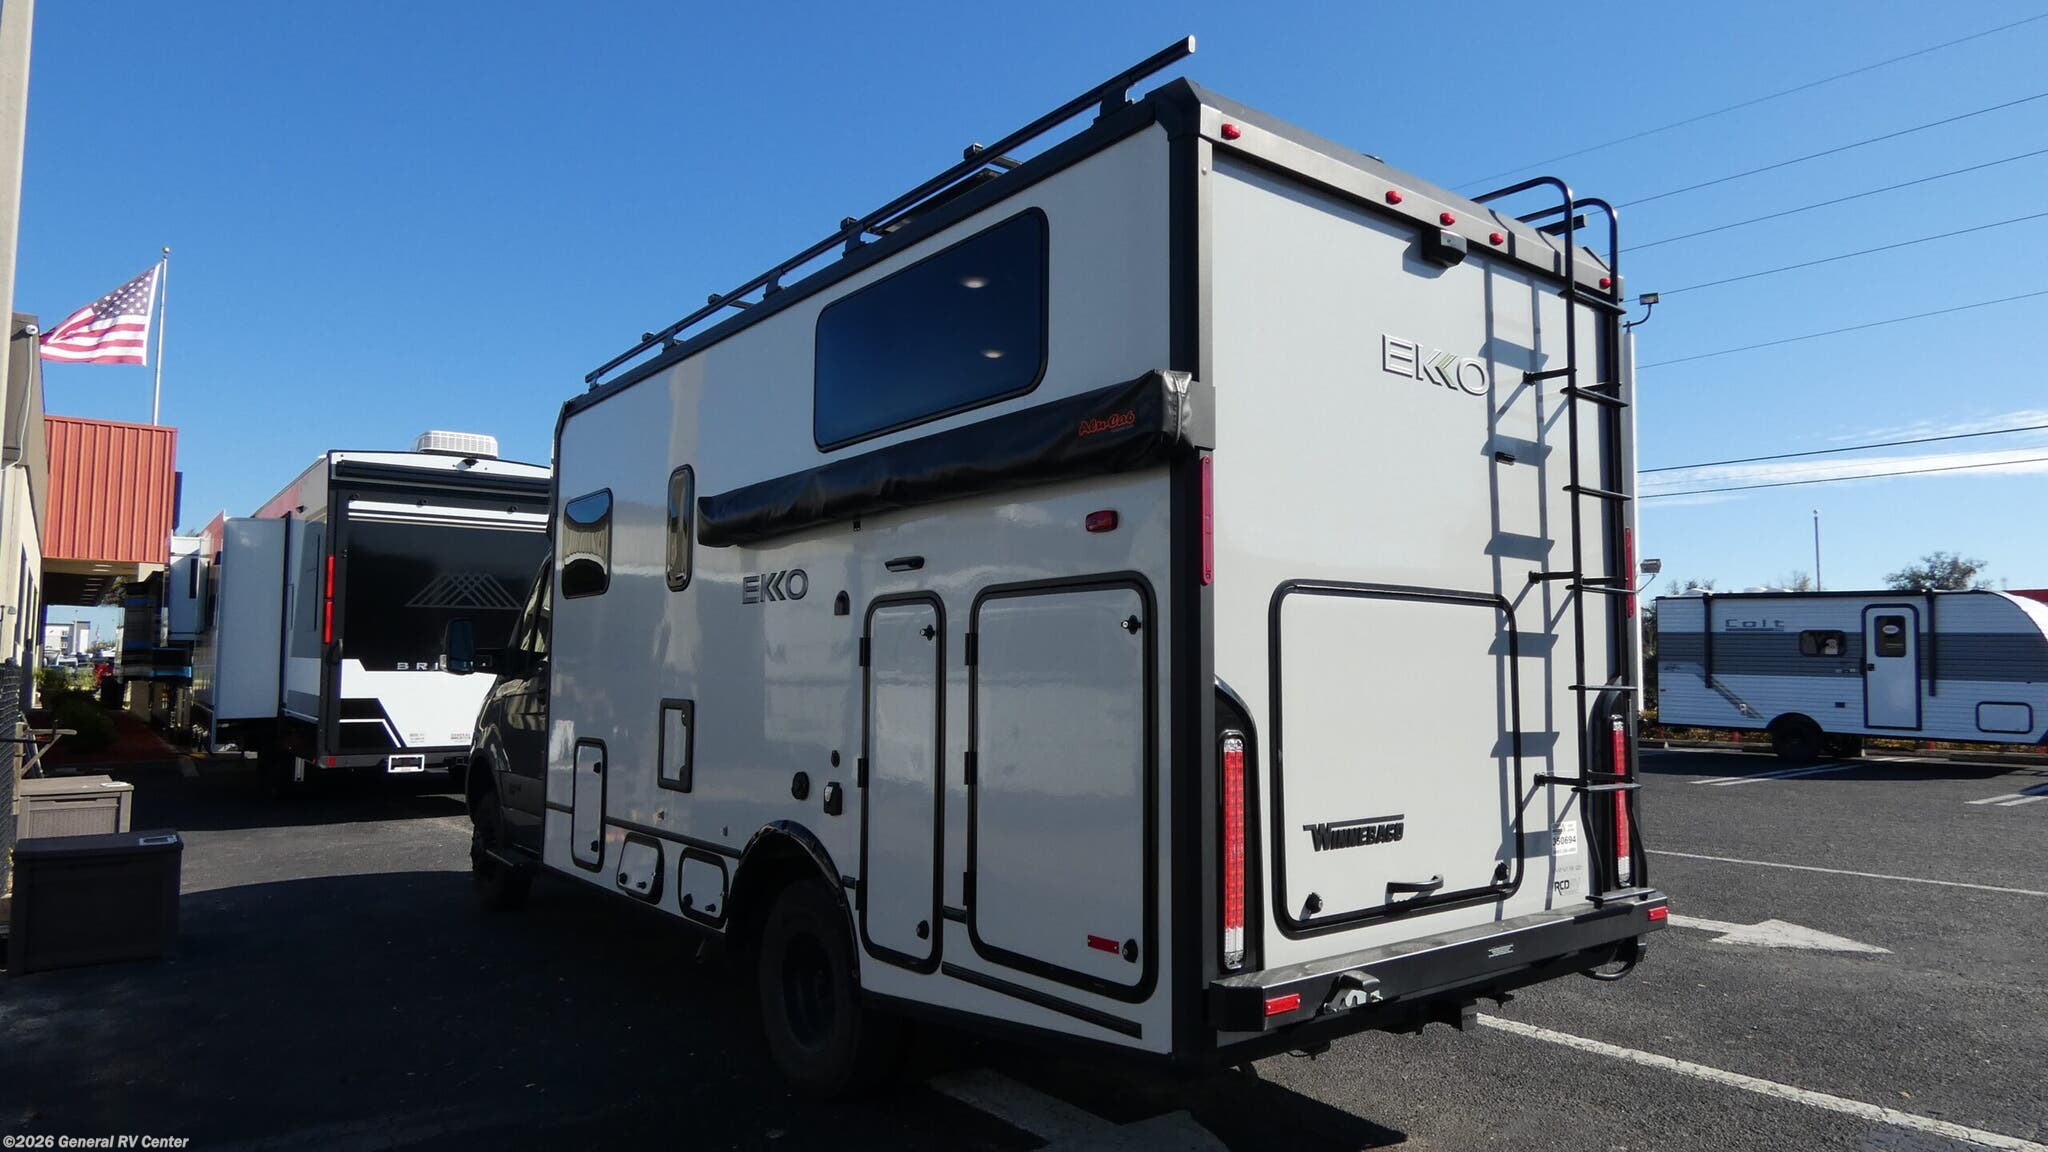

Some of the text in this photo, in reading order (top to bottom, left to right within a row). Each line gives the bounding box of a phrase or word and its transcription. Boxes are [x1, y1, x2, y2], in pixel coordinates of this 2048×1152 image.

[1381, 333, 1490, 396] EKKO
[742, 568, 809, 605] EKKO
[1725, 618, 1785, 629] Colt
[396, 662, 440, 671] BRI
[1302, 813, 1405, 852] WINNEBAGO
